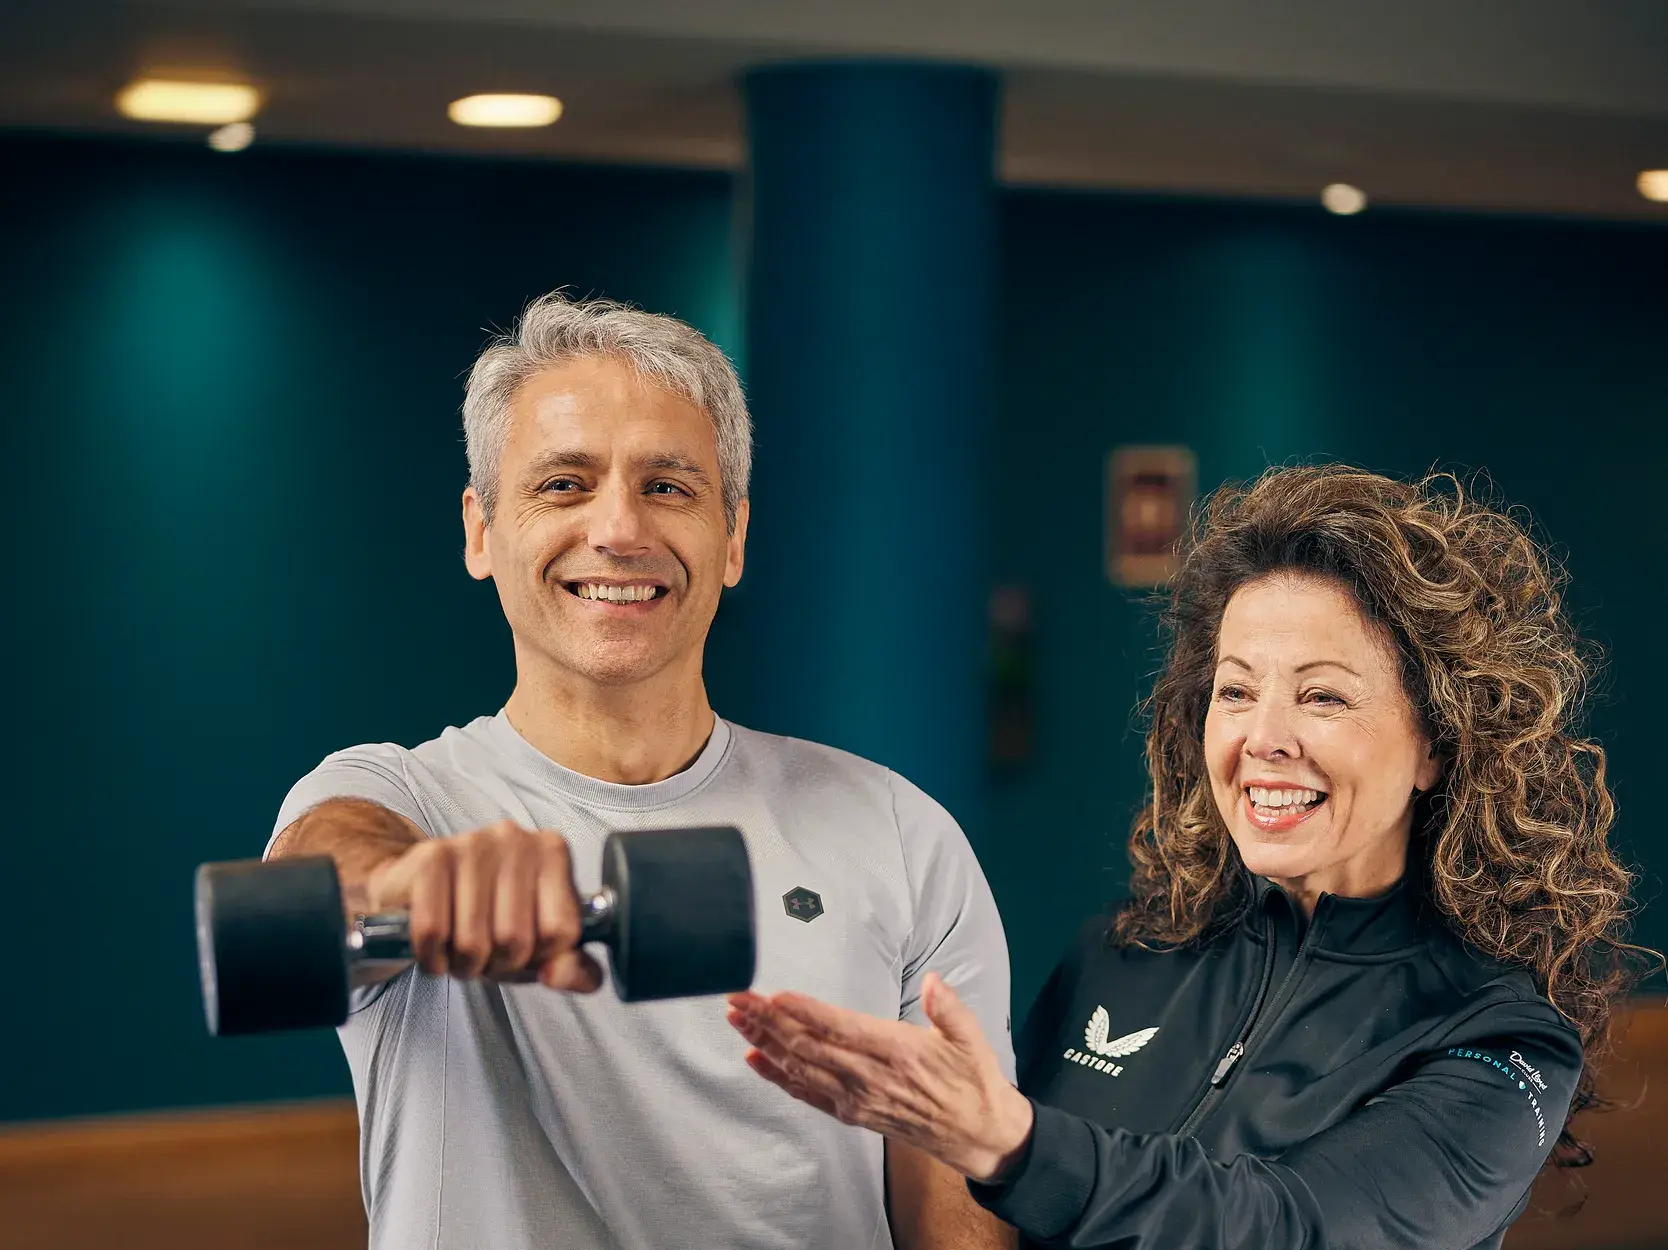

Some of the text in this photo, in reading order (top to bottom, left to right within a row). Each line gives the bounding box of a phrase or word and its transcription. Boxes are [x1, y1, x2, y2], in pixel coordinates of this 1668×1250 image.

[1063, 1048, 1124, 1077] CASTORE
[1509, 1050, 1547, 1090] David Lloyd
[1448, 1048, 1547, 1147] PERSONAL TRAINING
